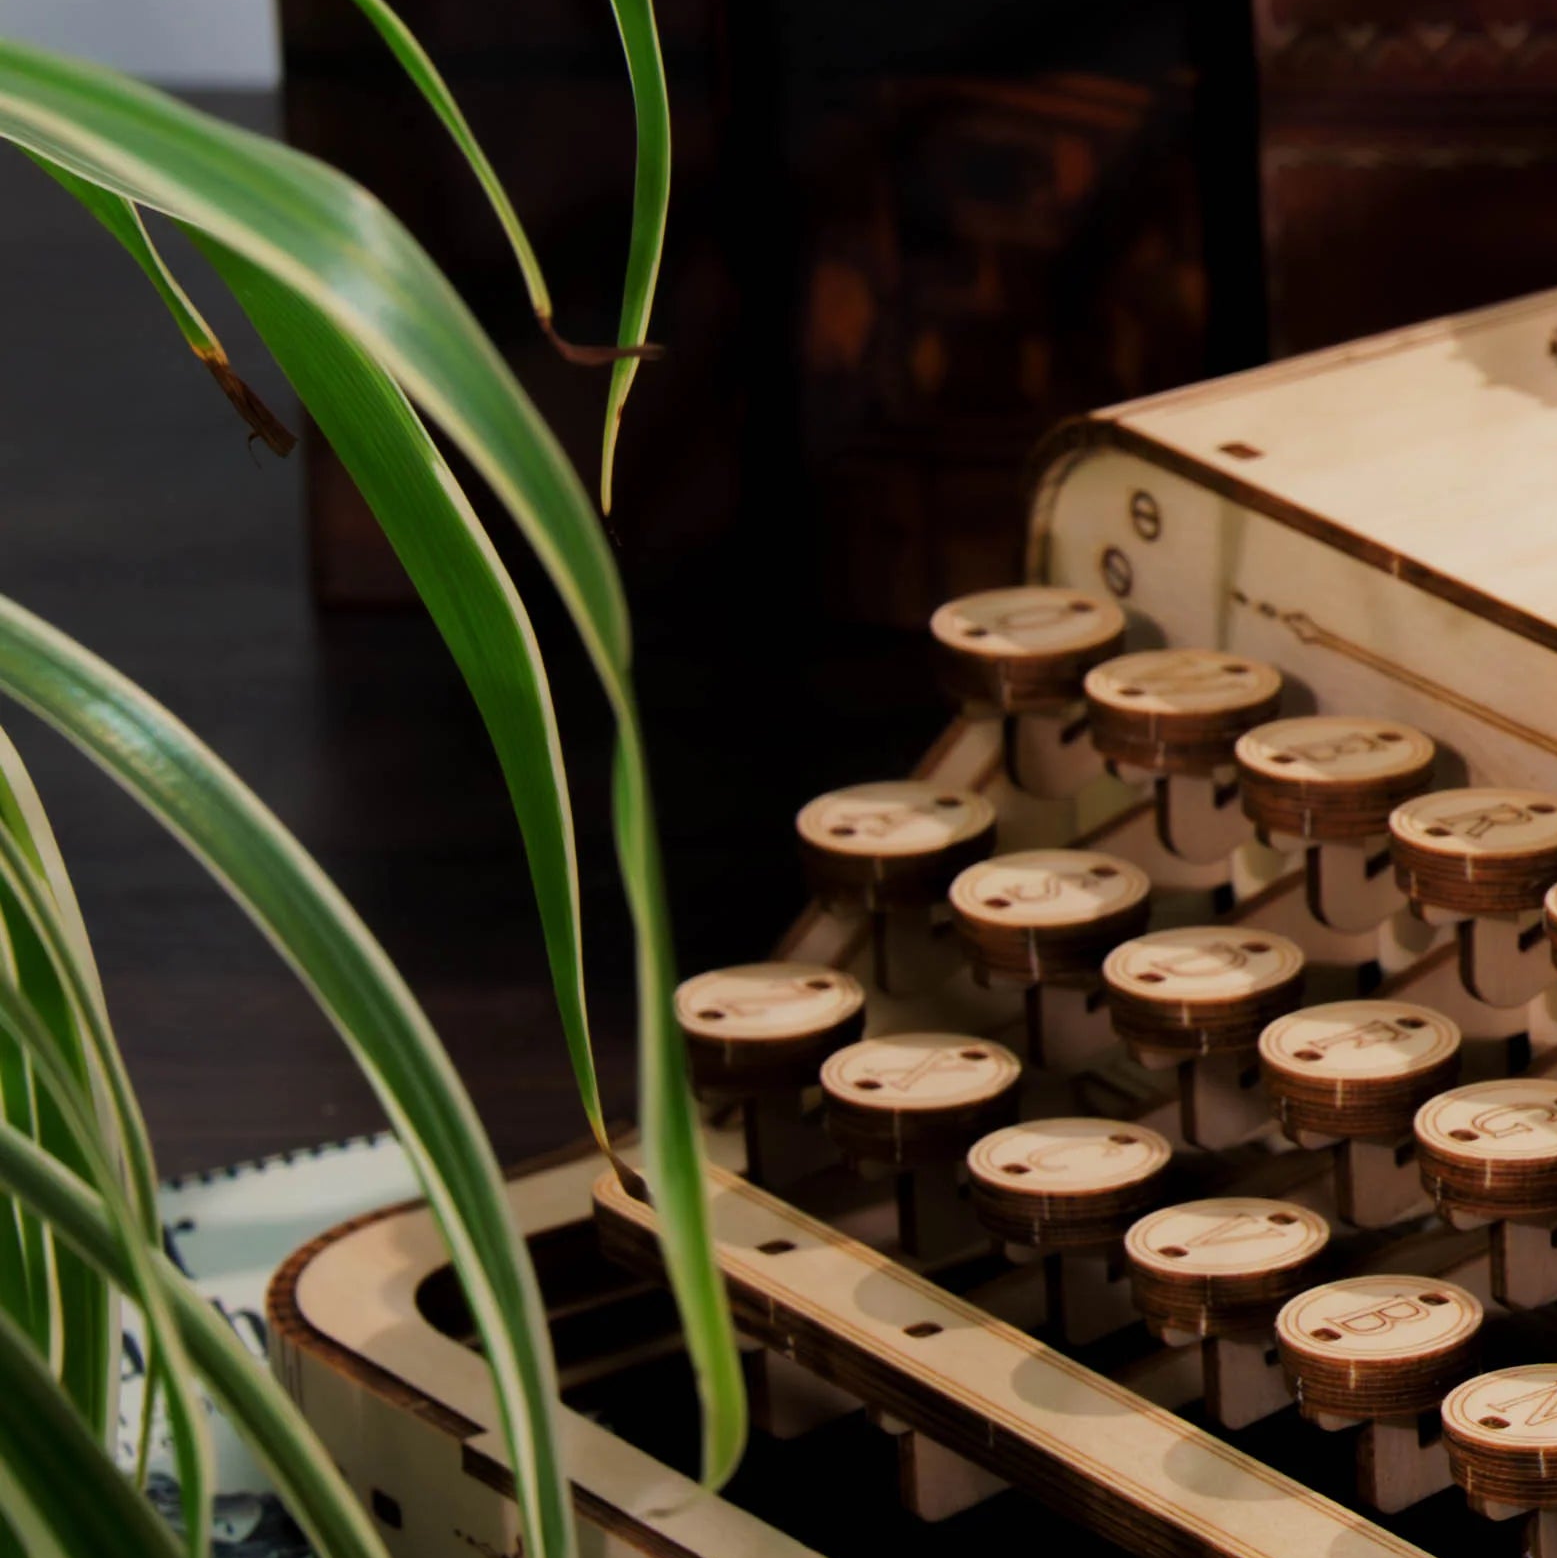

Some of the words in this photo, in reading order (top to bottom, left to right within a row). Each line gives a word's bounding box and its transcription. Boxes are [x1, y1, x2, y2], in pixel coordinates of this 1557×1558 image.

[1438, 803, 1532, 839] R
[1307, 1020, 1408, 1051] F
[1027, 1142, 1124, 1171] C
[1184, 1213, 1287, 1249] V
[1327, 1294, 1430, 1335] B
